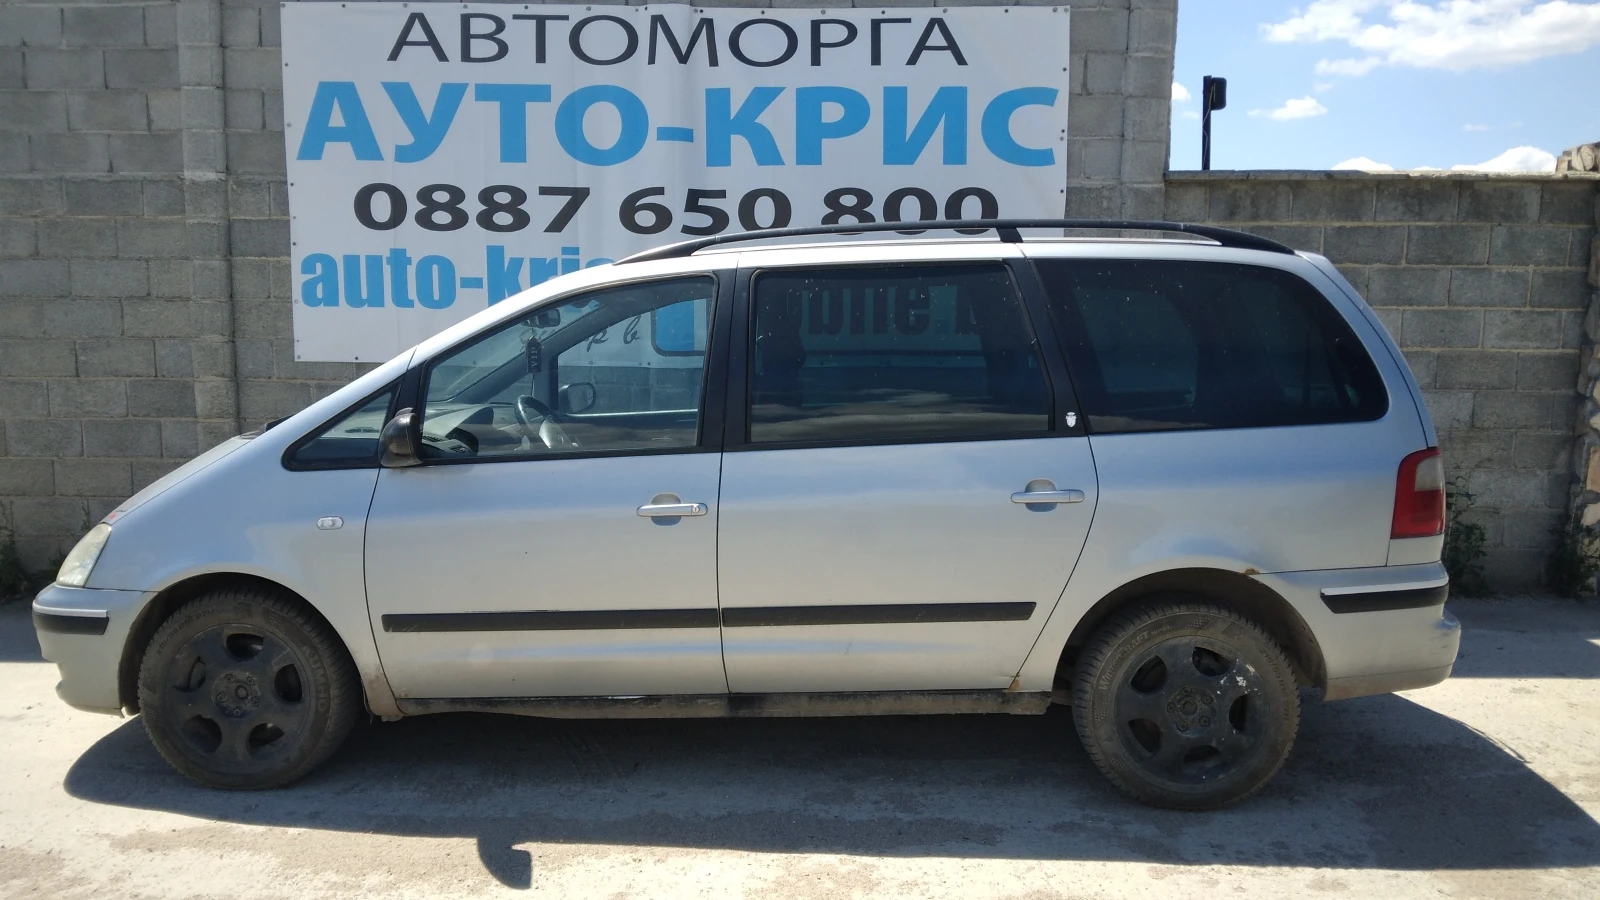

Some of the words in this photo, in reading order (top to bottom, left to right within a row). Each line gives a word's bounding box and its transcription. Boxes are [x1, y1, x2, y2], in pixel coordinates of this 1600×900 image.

[387, 12, 968, 67] АВТОМОРГА
[296, 80, 1059, 168] АУТО-КРИС
[353, 182, 591, 234] 0887
[618, 186, 793, 236] 650
[820, 186, 999, 236] 800
[530, 346, 538, 368] VIP
[302, 645, 330, 712] KUMHO
